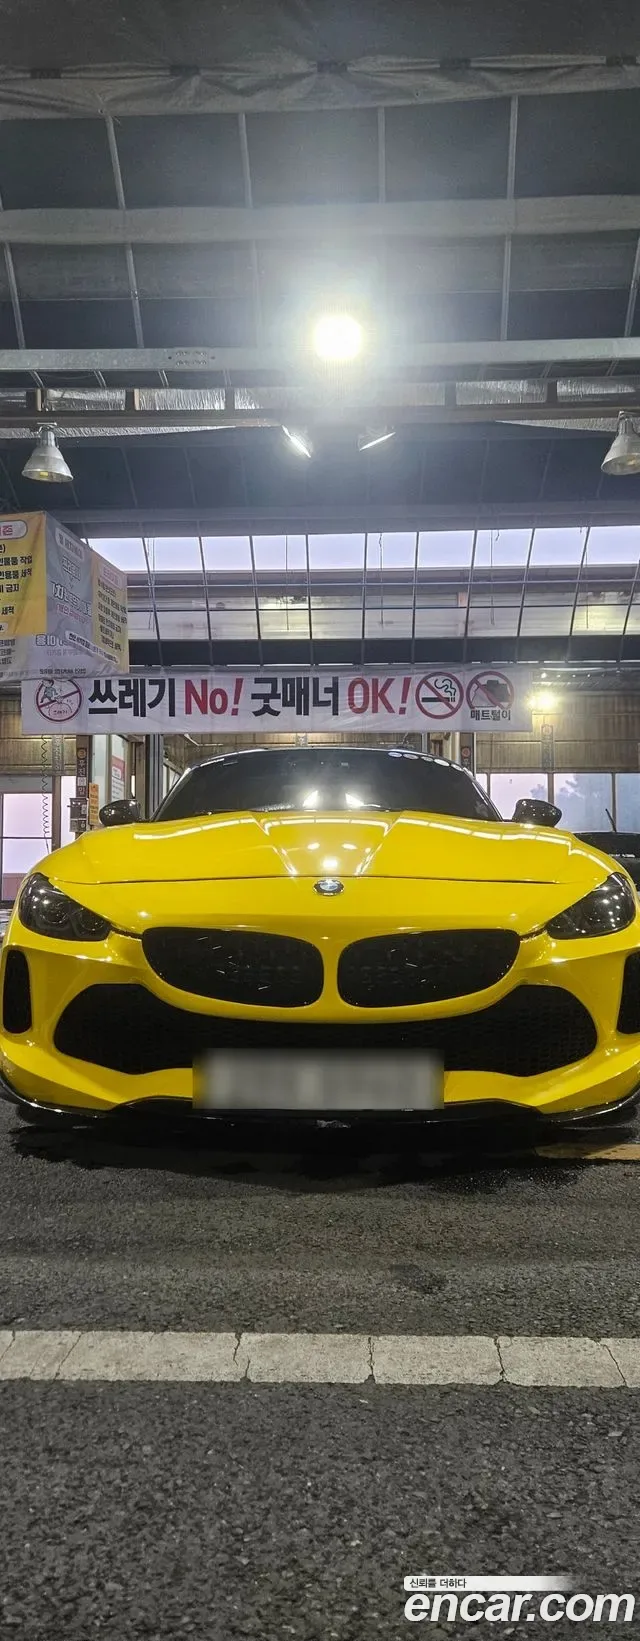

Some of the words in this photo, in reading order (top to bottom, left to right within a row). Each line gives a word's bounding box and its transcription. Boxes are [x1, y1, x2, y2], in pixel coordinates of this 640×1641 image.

[6, 583, 19, 593] 금지
[88, 678, 176, 717] 쓰레기
[184, 677, 244, 716] No!
[251, 676, 339, 717] 굿매너
[347, 676, 412, 715] OK!
[470, 709, 511, 721] 매트털이
